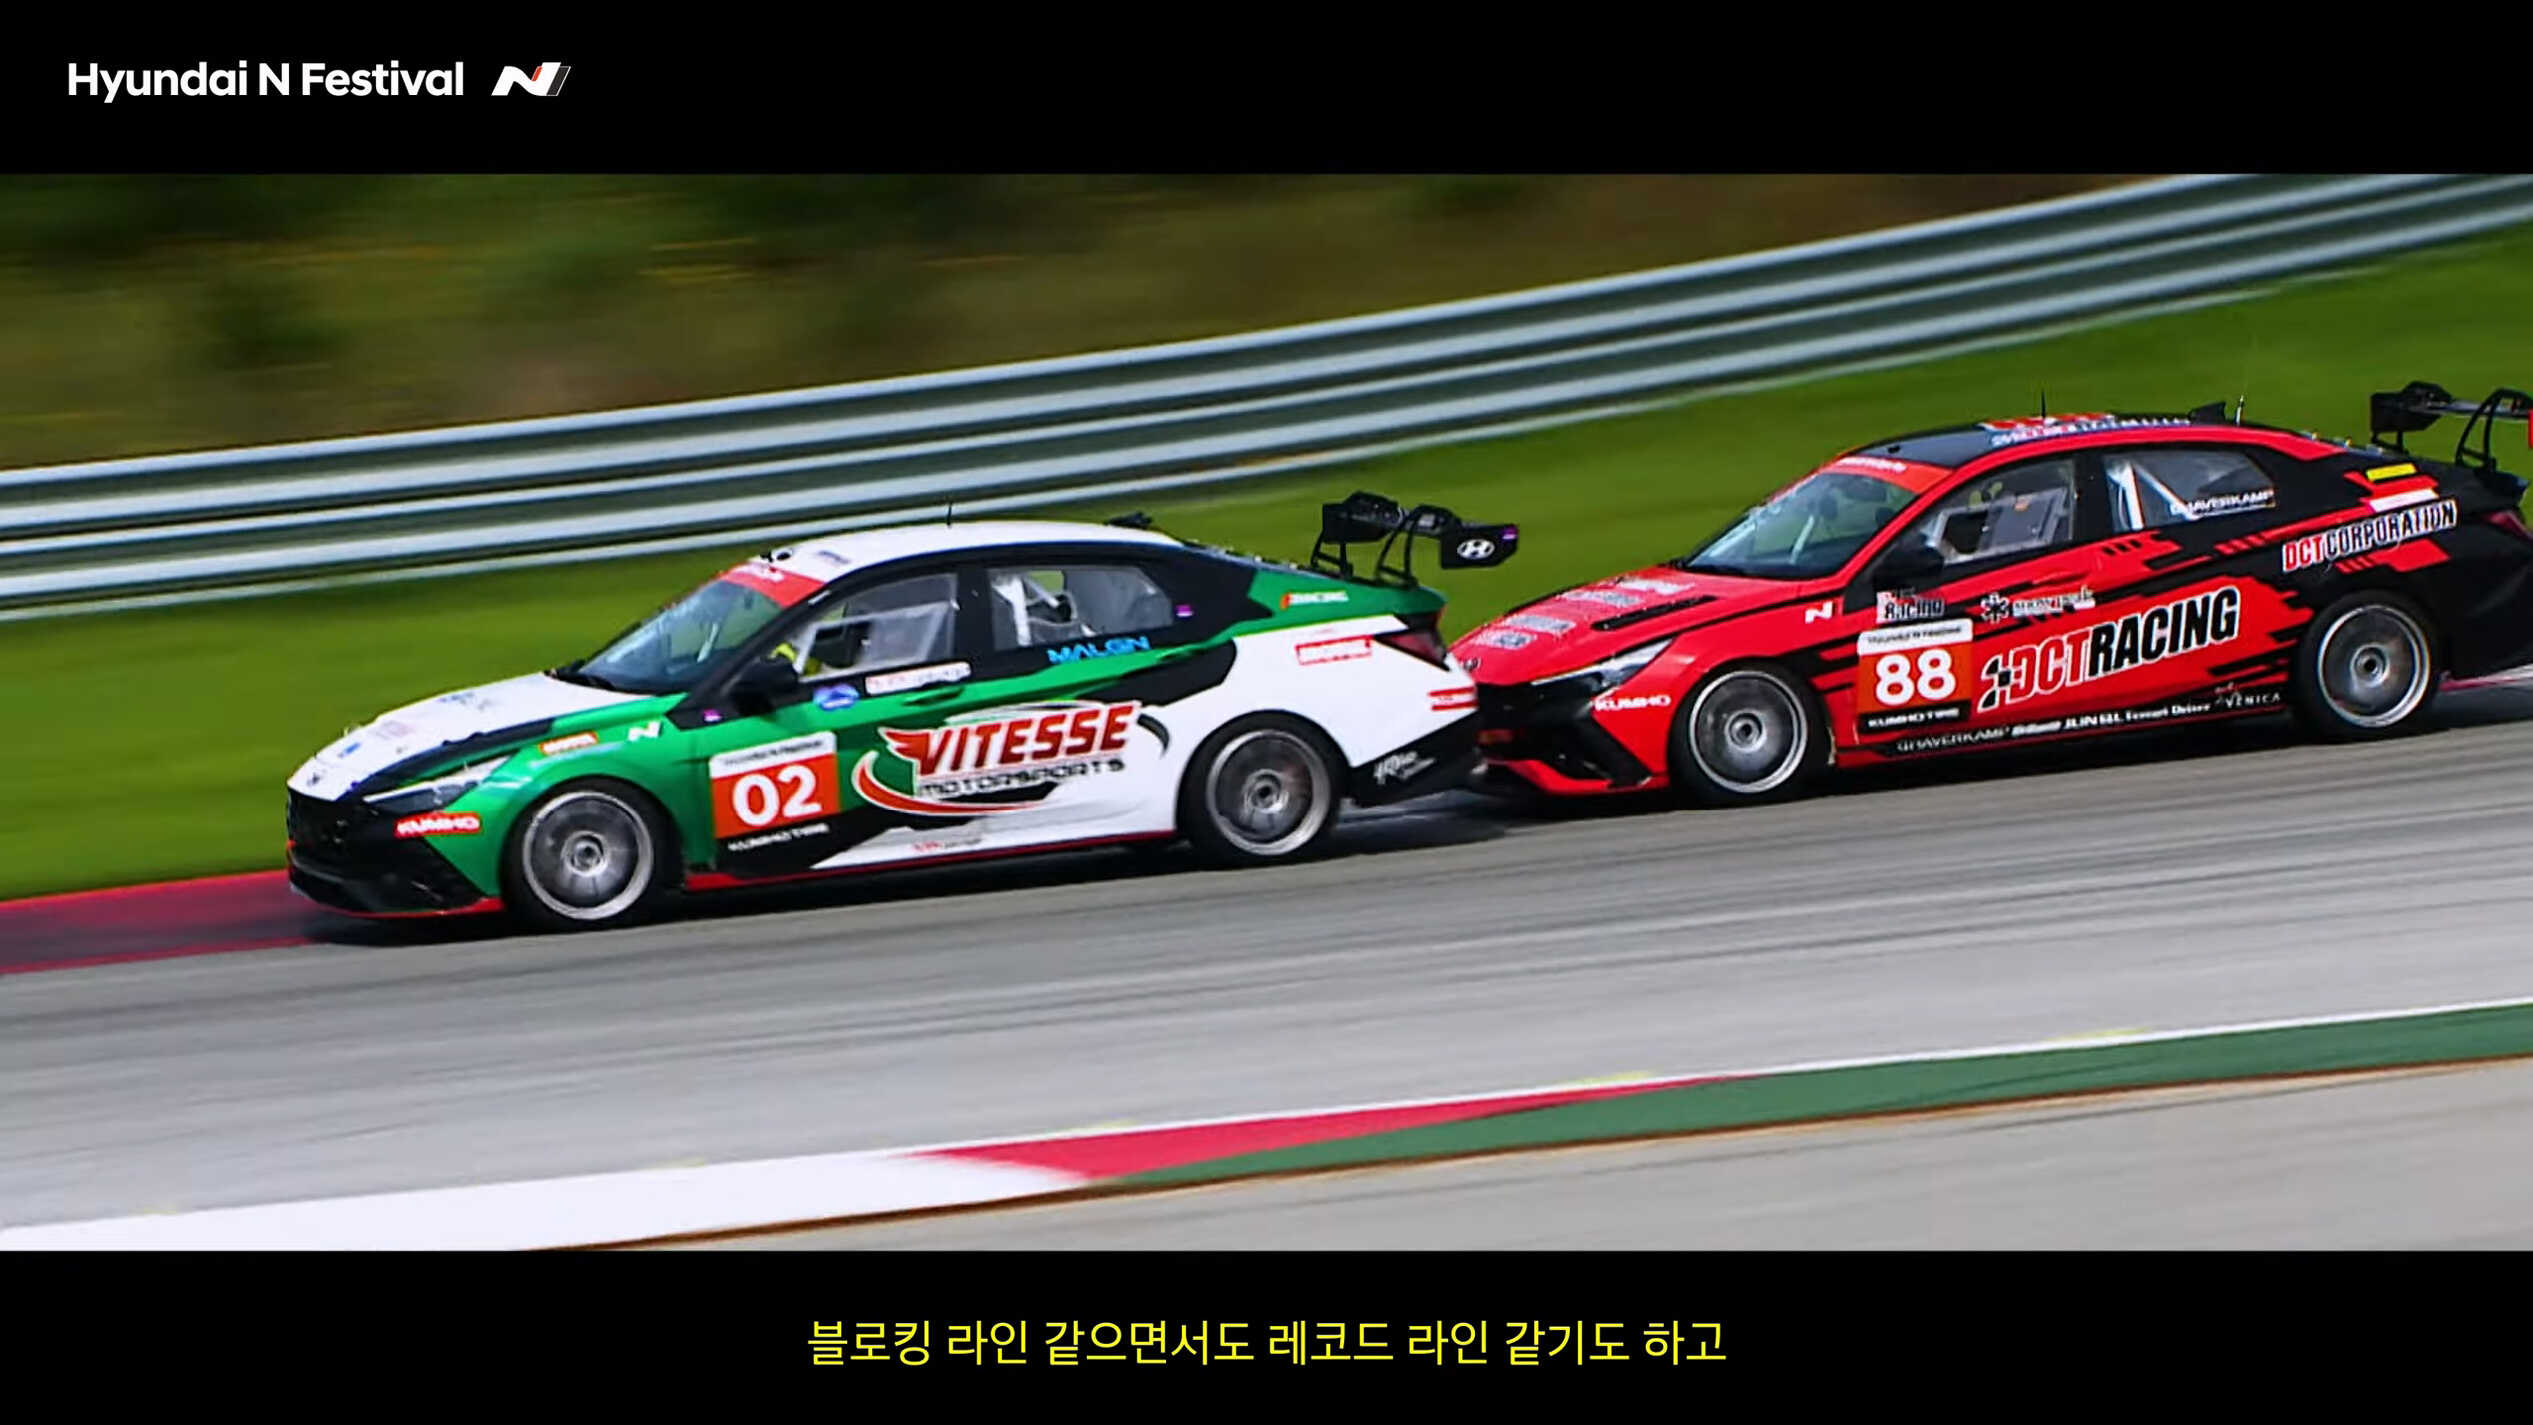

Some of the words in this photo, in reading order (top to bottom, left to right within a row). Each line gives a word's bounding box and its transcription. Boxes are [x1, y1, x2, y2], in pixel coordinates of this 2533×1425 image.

[1875, 648, 1957, 707] 88
[884, 704, 1136, 777] VITESSE
[732, 763, 823, 828] 02
[918, 758, 1126, 798] MOTORSPORTS
